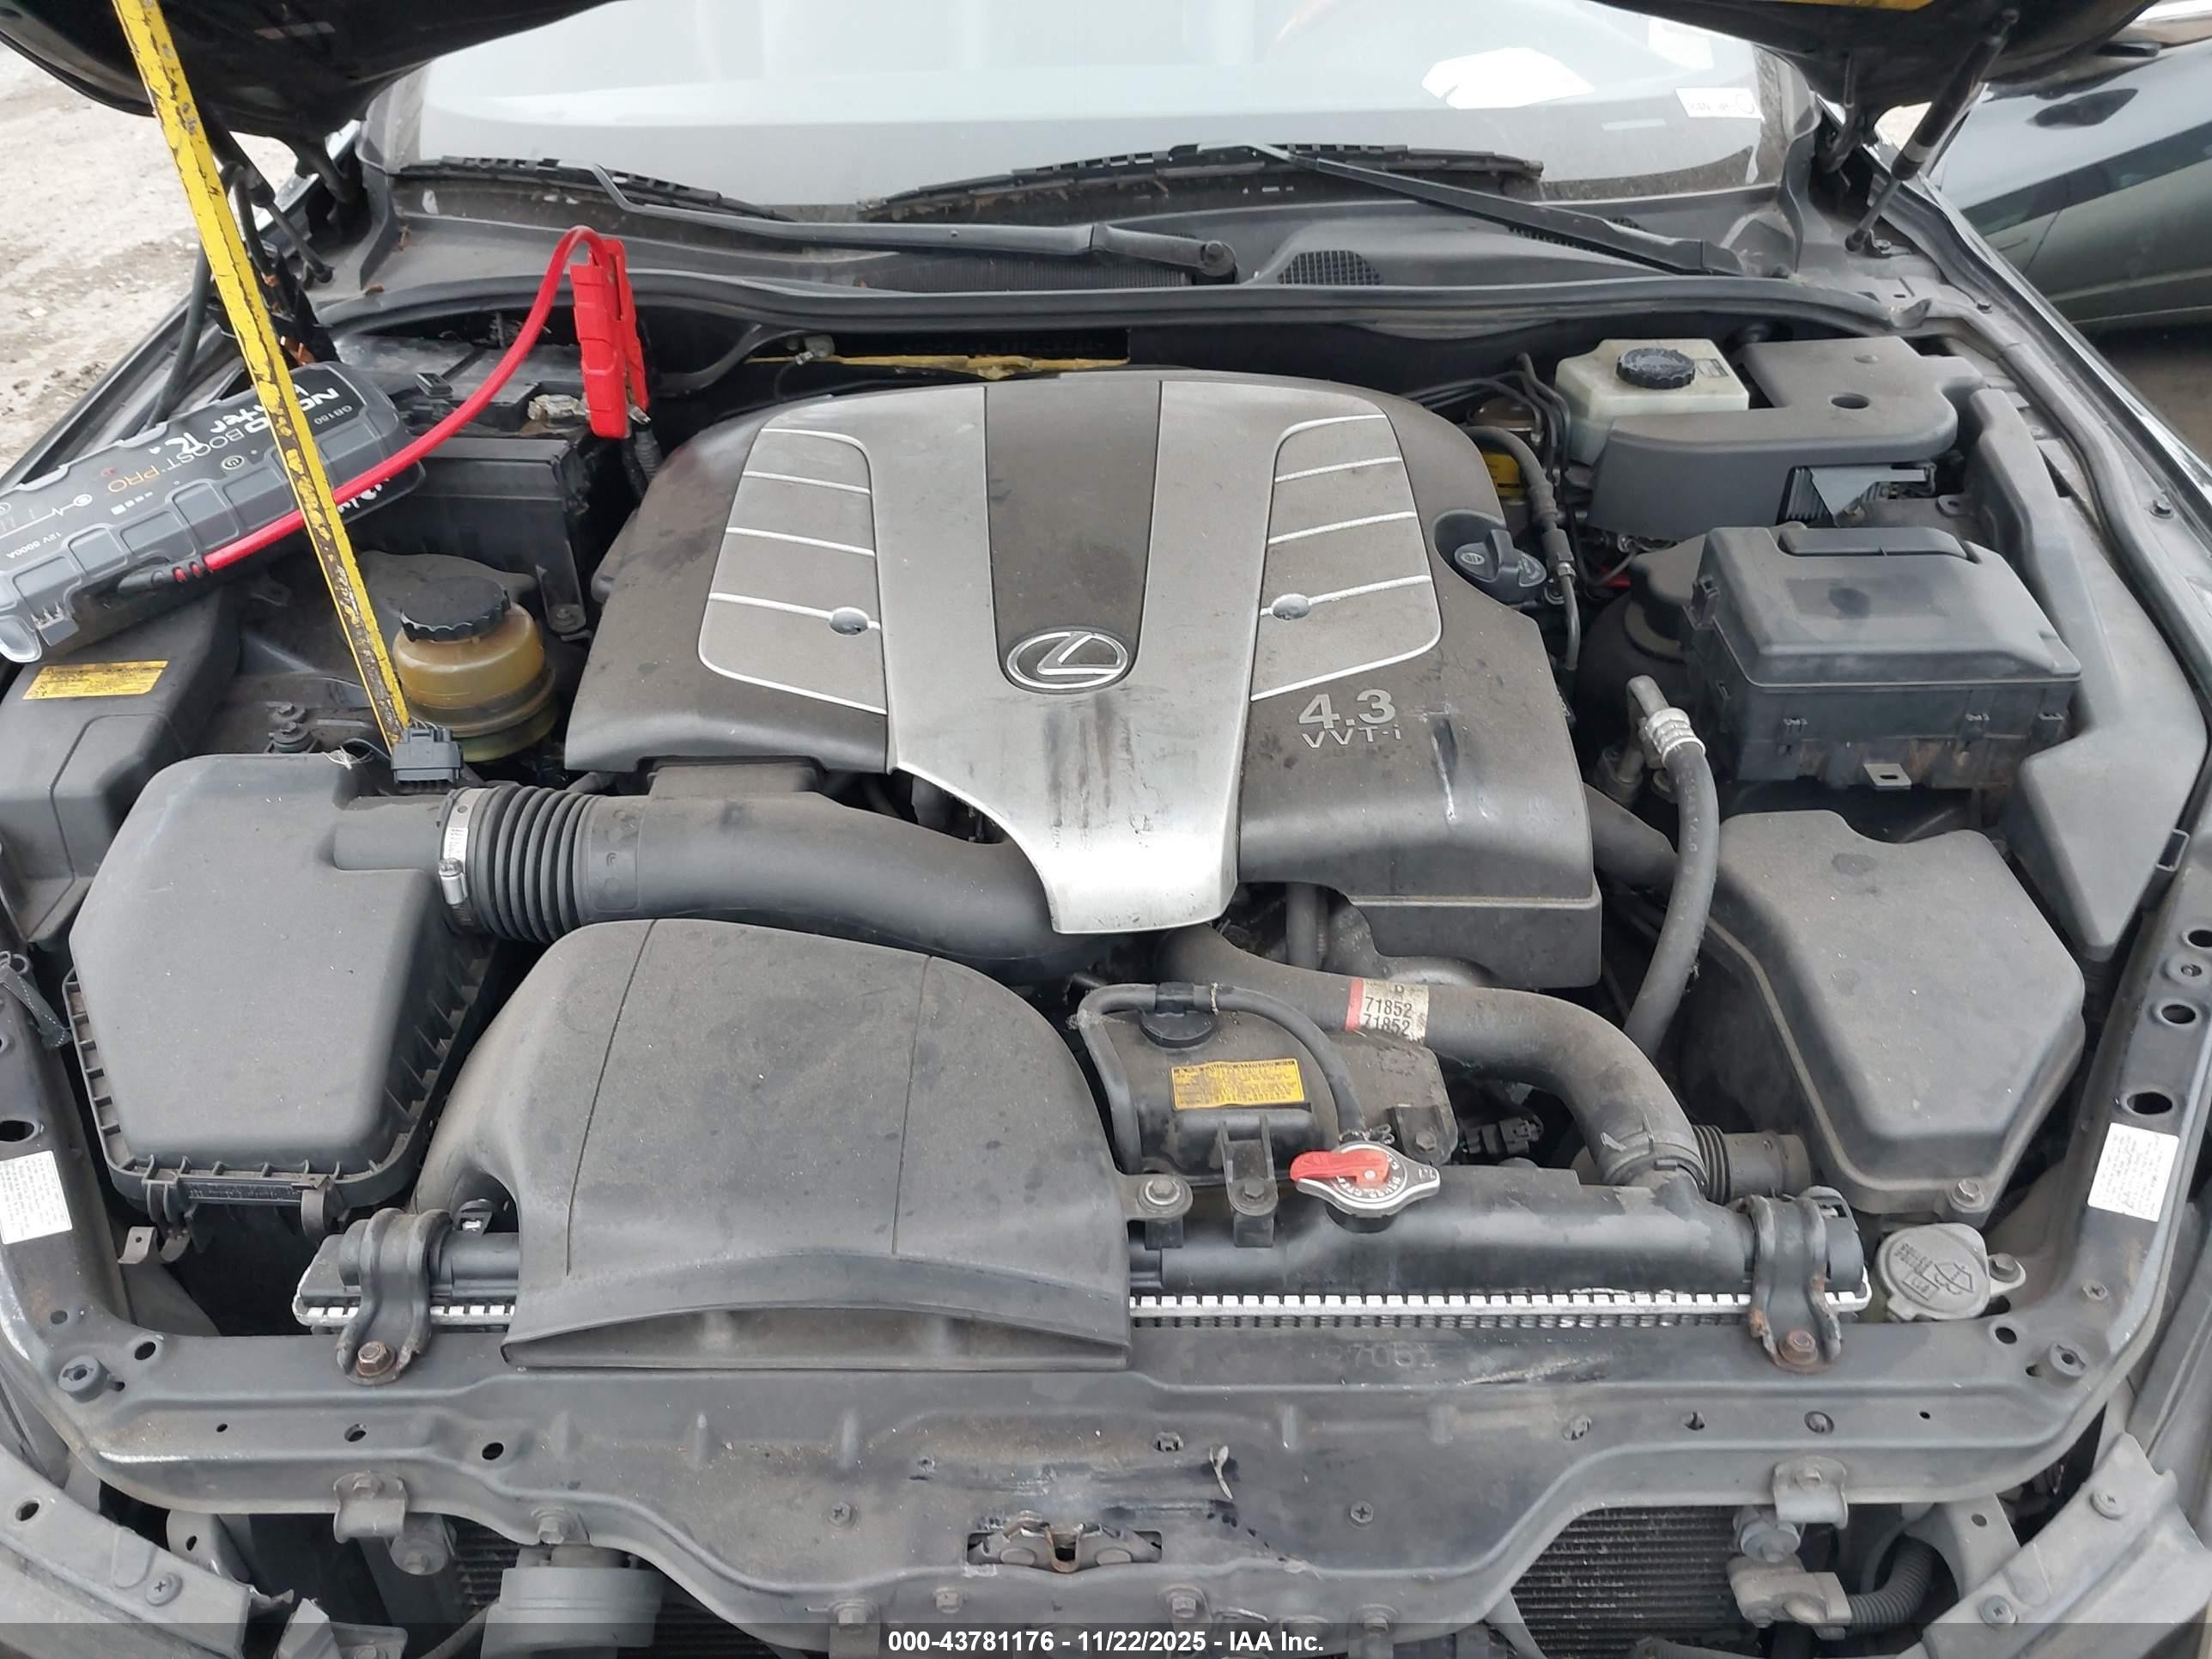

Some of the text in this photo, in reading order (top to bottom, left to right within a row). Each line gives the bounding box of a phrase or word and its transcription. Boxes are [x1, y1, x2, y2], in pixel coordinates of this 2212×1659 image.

[244, 387, 340, 434] NOO
[108, 465, 161, 493] PRO
[1298, 689, 1396, 729] 4.3
[1301, 724, 1401, 749] VVT-i
[1364, 995, 1413, 1019] 71852
[1363, 1012, 1411, 1037] 71852
